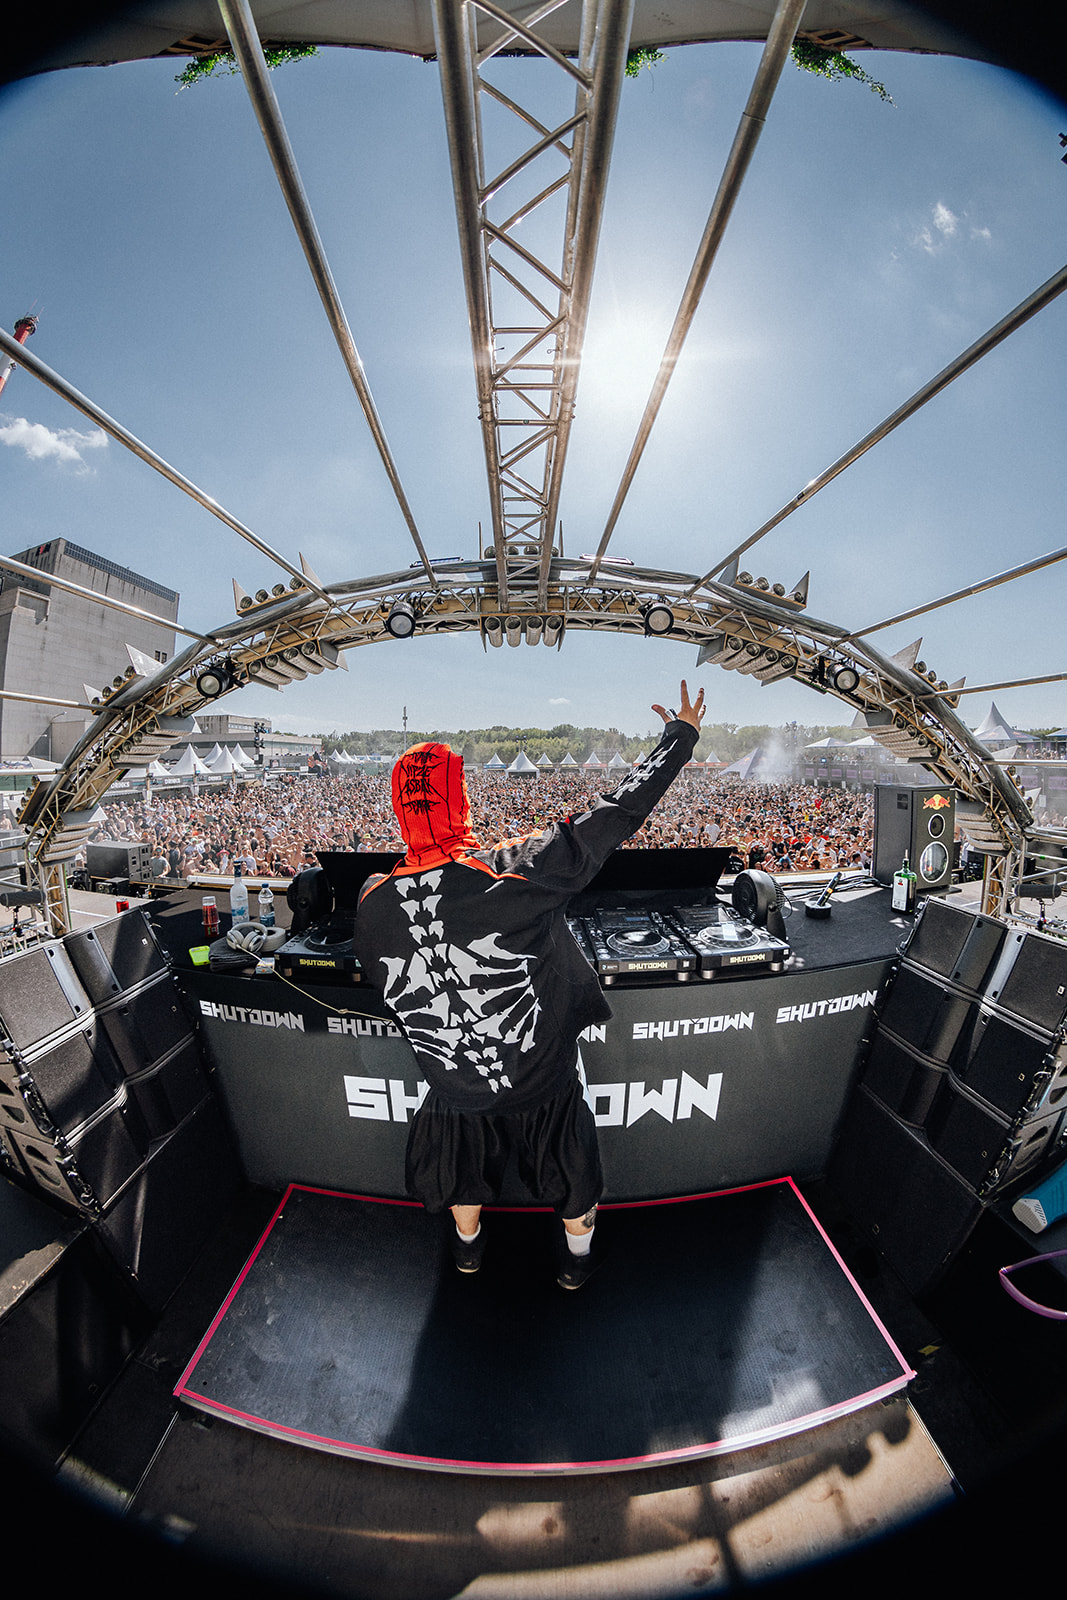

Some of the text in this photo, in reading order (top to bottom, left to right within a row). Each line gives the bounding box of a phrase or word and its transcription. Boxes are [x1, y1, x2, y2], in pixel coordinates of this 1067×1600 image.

[299, 958, 336, 968] SHUTDOWN
[628, 961, 668, 970] SHUTDOWN
[730, 953, 766, 964] SHUTDOWN
[200, 1000, 305, 1032] SHUTDOWN
[776, 989, 878, 1024] SHUTDOWN
[327, 1016, 403, 1038] SHUTD
[632, 1011, 754, 1042] SHUTDOWN
